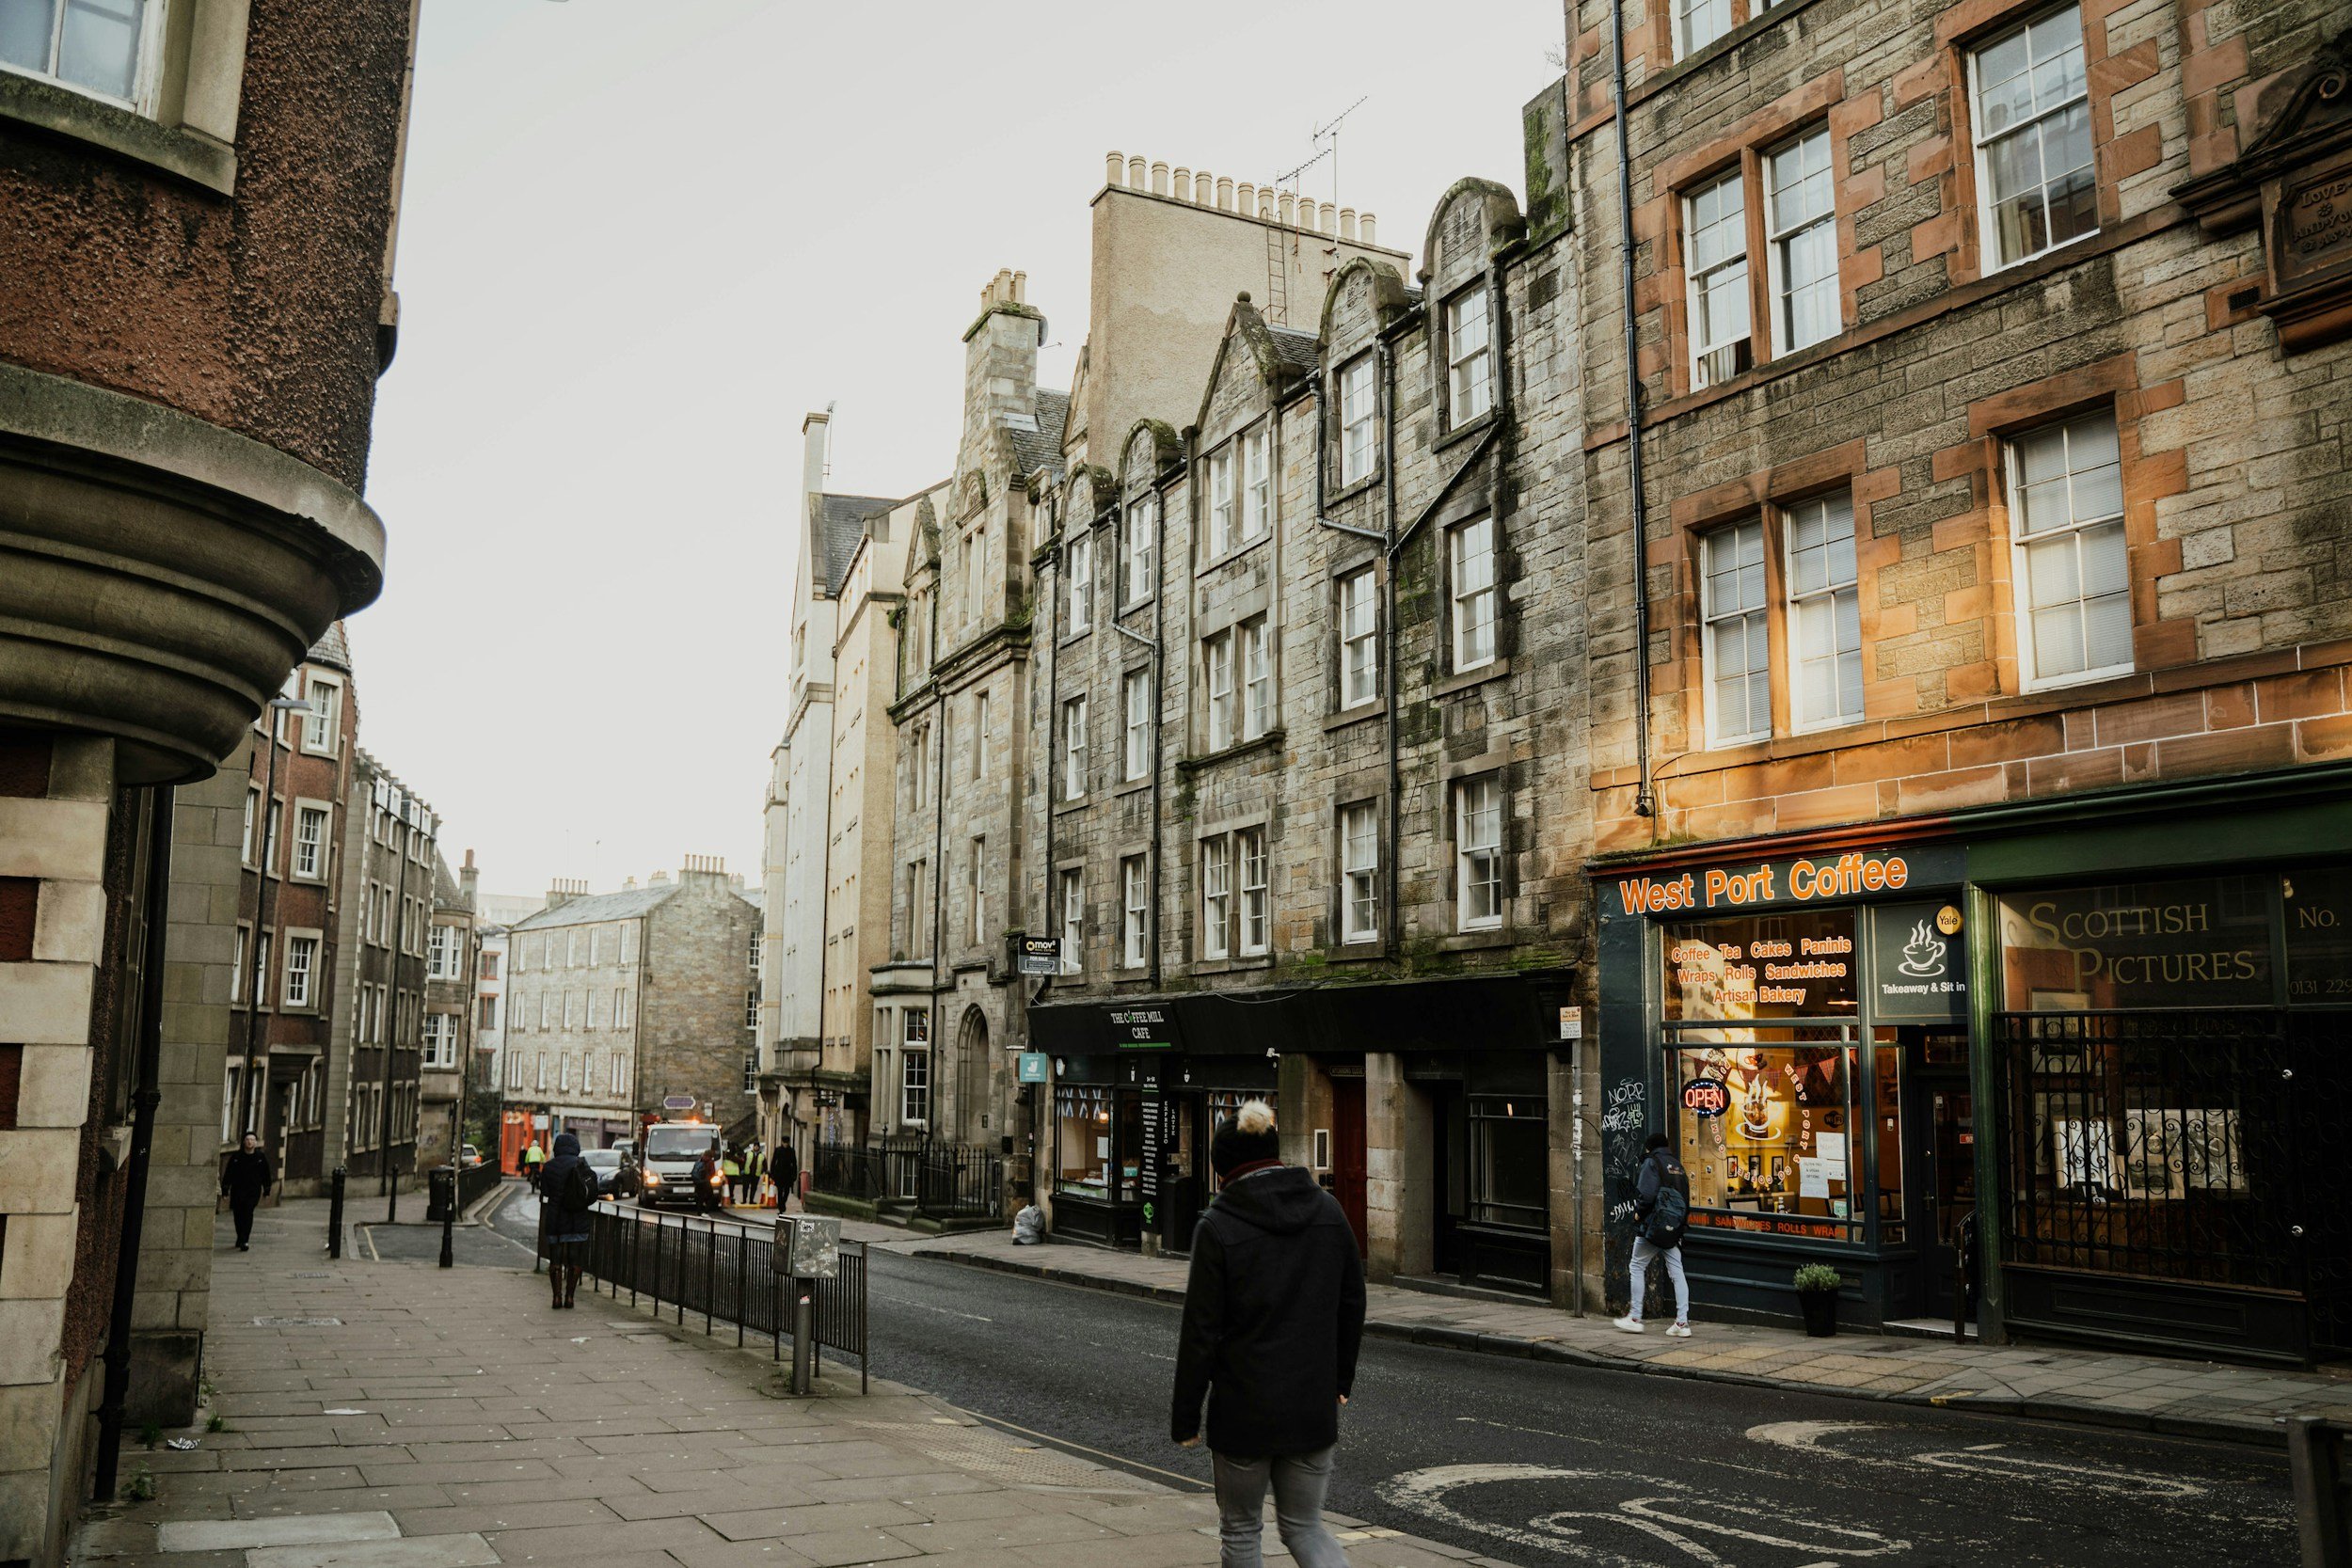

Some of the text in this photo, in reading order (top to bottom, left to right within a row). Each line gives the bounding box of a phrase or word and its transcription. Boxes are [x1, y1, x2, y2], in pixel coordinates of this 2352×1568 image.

[2301, 182, 2346, 208] LOVE
[1619, 852, 1908, 915] West Port Coffee
[1939, 915, 1958, 926] Yale
[1672, 936, 1851, 963] Coffee Tea Cakes Paninis
[1677, 960, 1847, 985] Wraps Rolls Sandwiches
[1713, 986, 1806, 1006] Artisan Bakery
[1882, 982, 1965, 995] Takeaway & Sit in
[2290, 980, 2318, 994] 0131
[1110, 1012, 1124, 1023] THE
[1147, 1010, 1164, 1022] MILL
[1132, 1027, 1151, 1038] CAFE
[1685, 1088, 1724, 1108] OPEN
[1687, 1212, 1847, 1239] ANINI SANDWICHES ROLLS WRAPS
